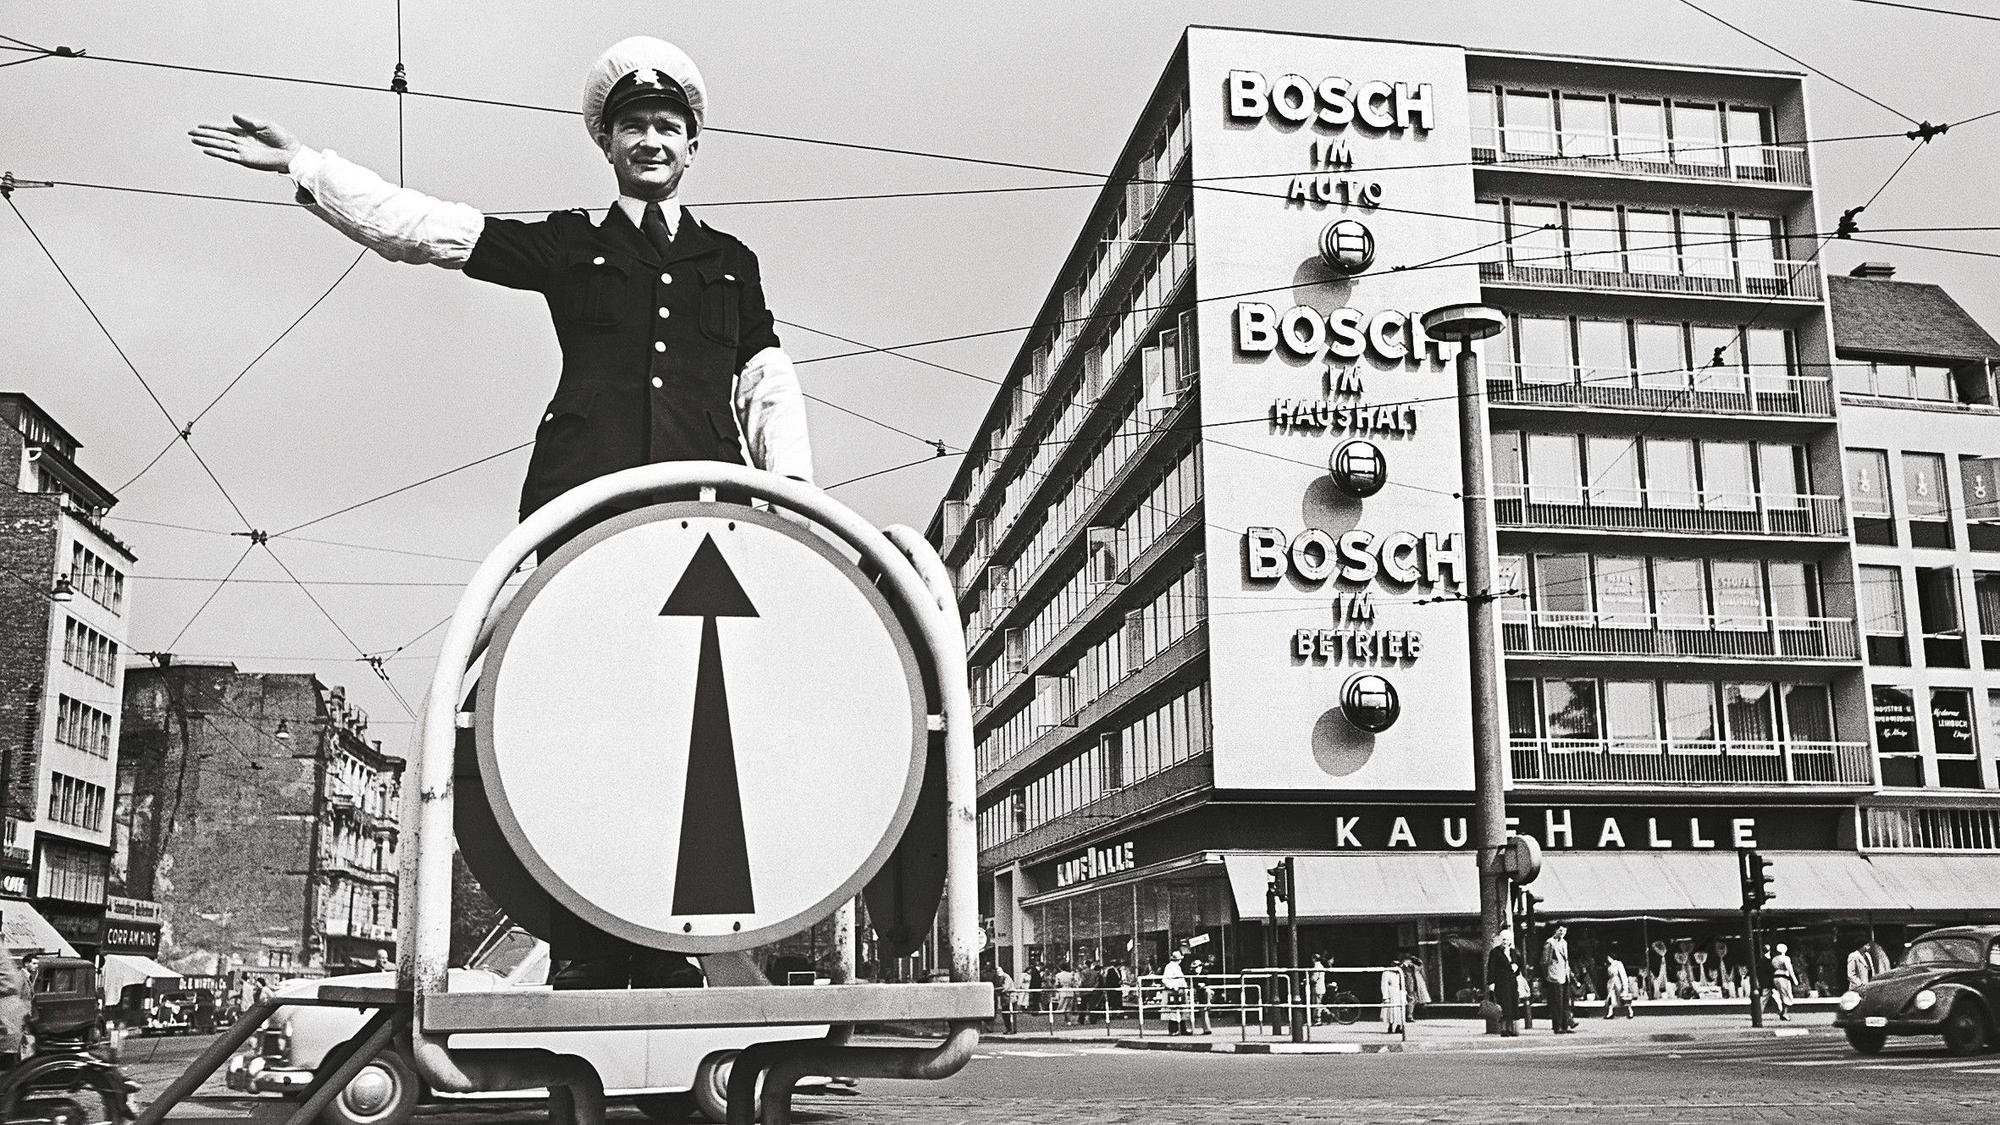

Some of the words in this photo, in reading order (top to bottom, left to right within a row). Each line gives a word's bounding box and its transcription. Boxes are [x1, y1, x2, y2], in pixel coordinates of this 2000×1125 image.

[1229, 69, 1435, 130] BOSCH
[1314, 138, 1354, 165] IM
[1289, 175, 1387, 207] AUTO
[1327, 366, 1364, 393] IM
[1274, 398, 1425, 432] HAUSHALT
[1247, 526, 1465, 584] BOSCH
[1339, 592, 1376, 619] IM
[1296, 629, 1425, 659] BETRIEB
[1057, 841, 1135, 888] KAUFHALLE
